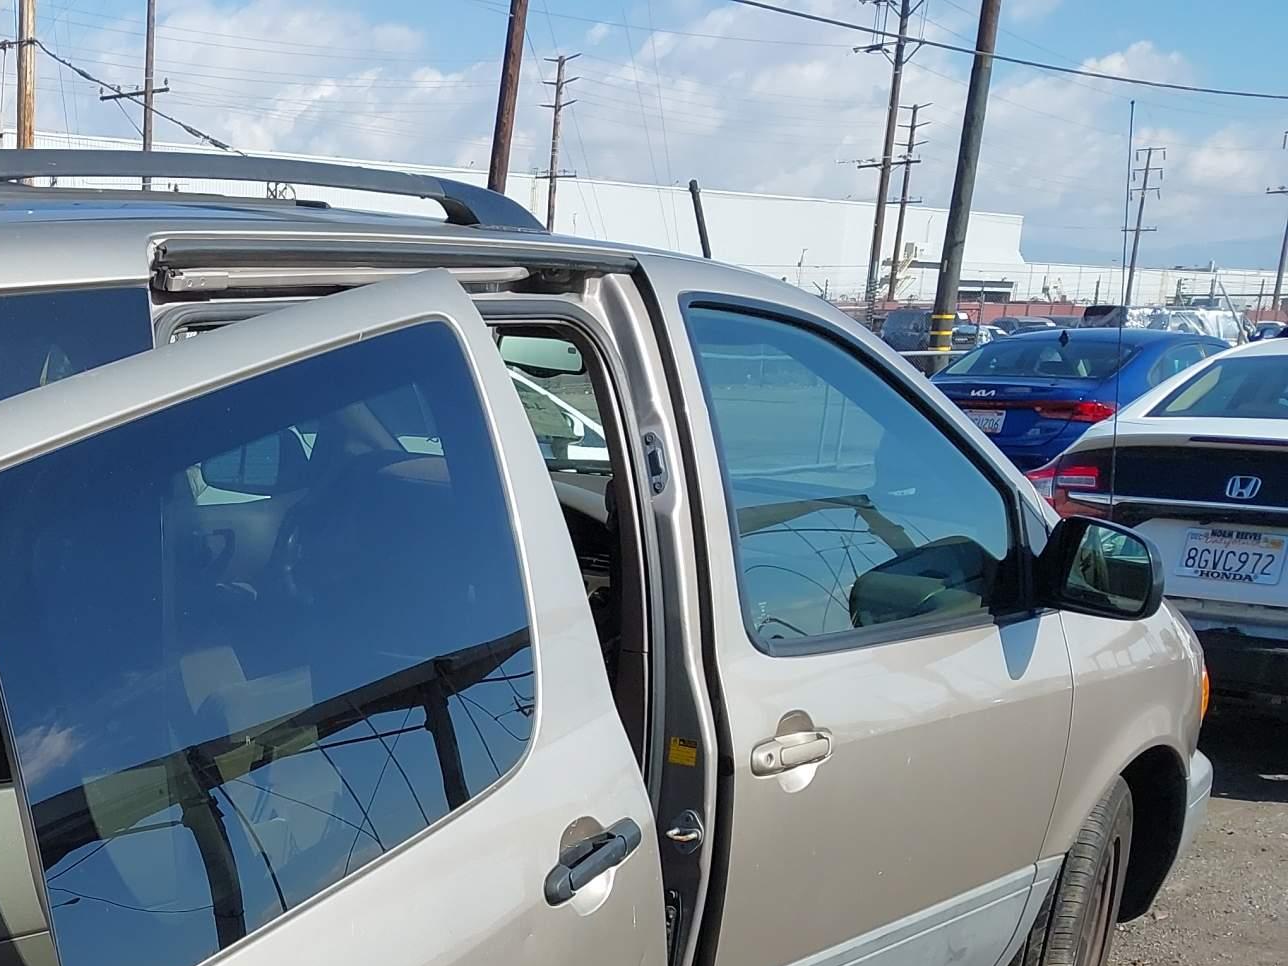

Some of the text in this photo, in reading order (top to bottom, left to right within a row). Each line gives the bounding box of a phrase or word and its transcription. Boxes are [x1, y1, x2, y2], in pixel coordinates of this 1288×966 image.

[970, 389, 996, 397] KIA
[1184, 547, 1275, 576] 8GVC972
[1199, 570, 1254, 582] HONDA
